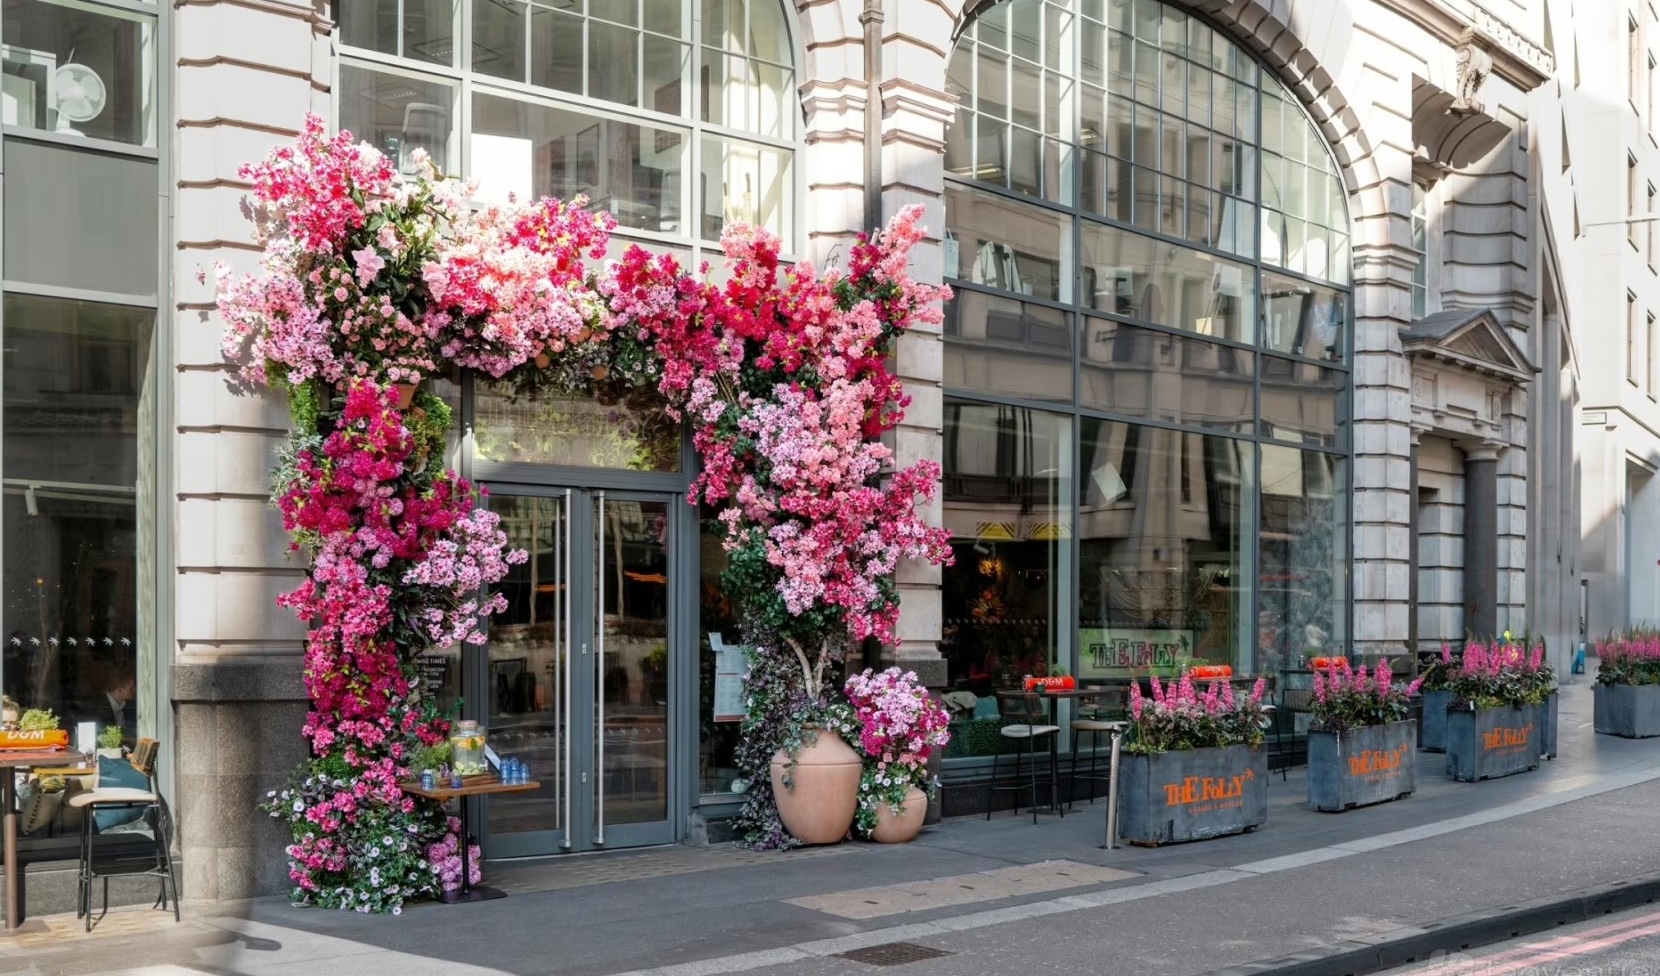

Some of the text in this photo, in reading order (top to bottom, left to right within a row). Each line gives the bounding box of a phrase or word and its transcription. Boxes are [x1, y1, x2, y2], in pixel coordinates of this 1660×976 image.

[1089, 638, 1180, 669] THE FOLLY
[1163, 775, 1246, 806] THE FOLLY
